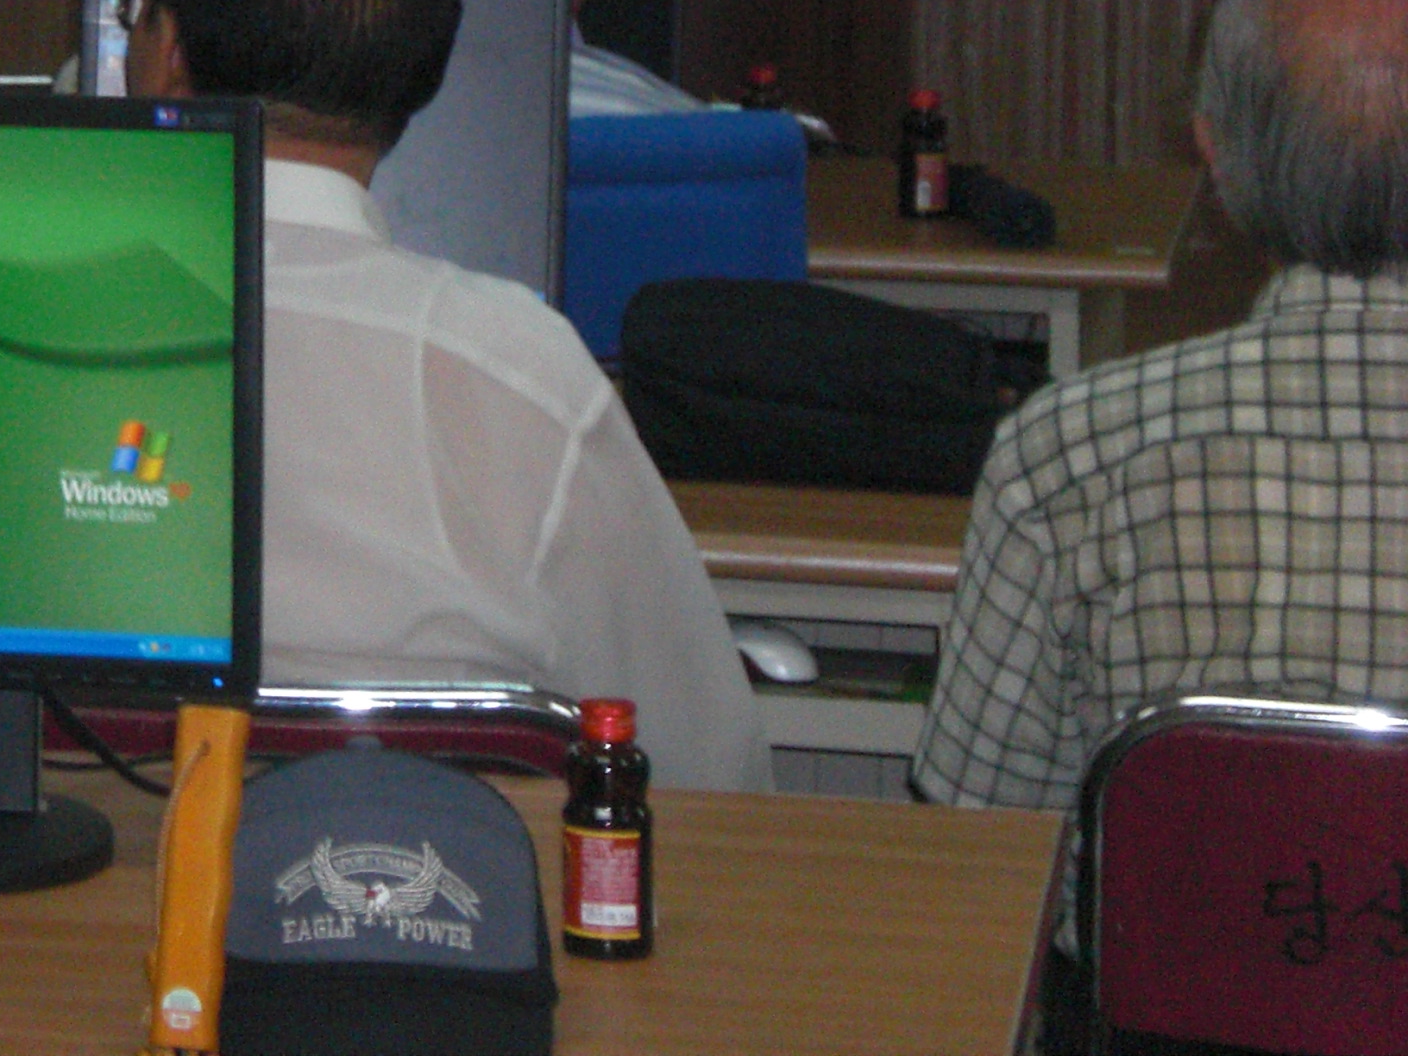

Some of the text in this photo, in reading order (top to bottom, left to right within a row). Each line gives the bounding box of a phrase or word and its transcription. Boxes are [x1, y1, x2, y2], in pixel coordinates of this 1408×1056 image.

[61, 478, 169, 508] Windows
[283, 914, 475, 951] EAGLE POWER
